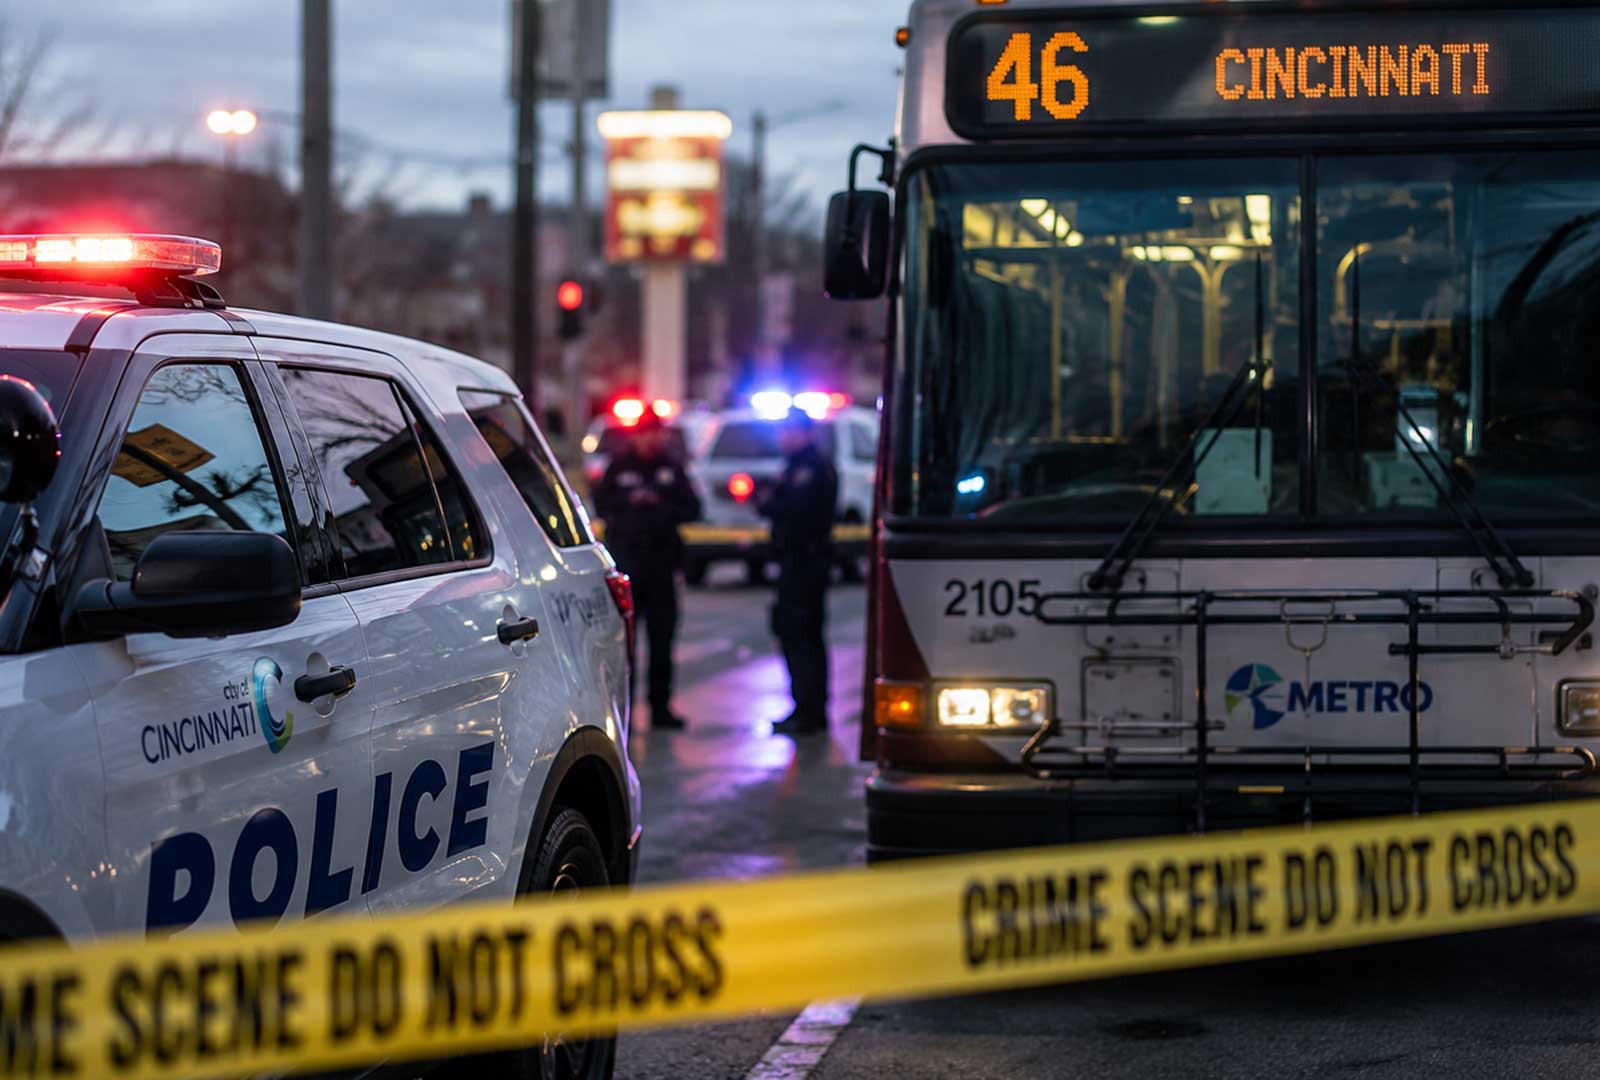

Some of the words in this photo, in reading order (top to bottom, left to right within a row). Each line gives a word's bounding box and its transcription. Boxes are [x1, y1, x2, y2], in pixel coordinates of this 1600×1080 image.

[986, 32, 1089, 121] 46
[1215, 43, 1490, 100] CINCINNATI
[944, 579, 1042, 617] 2105
[141, 702, 256, 764] CINCINNATI
[1287, 680, 1433, 713] METRO
[145, 741, 495, 941] POLICE
[963, 871, 1109, 970] CRIME
[1128, 853, 1265, 948] SCENE
[1284, 846, 1339, 930] DO
[1354, 837, 1432, 924] NOT
[1448, 823, 1578, 914] CROSS
[108, 949, 306, 1071] SCENE
[330, 935, 404, 1044] DO
[425, 924, 530, 1032] NOT
[553, 905, 726, 1018] CROSS
